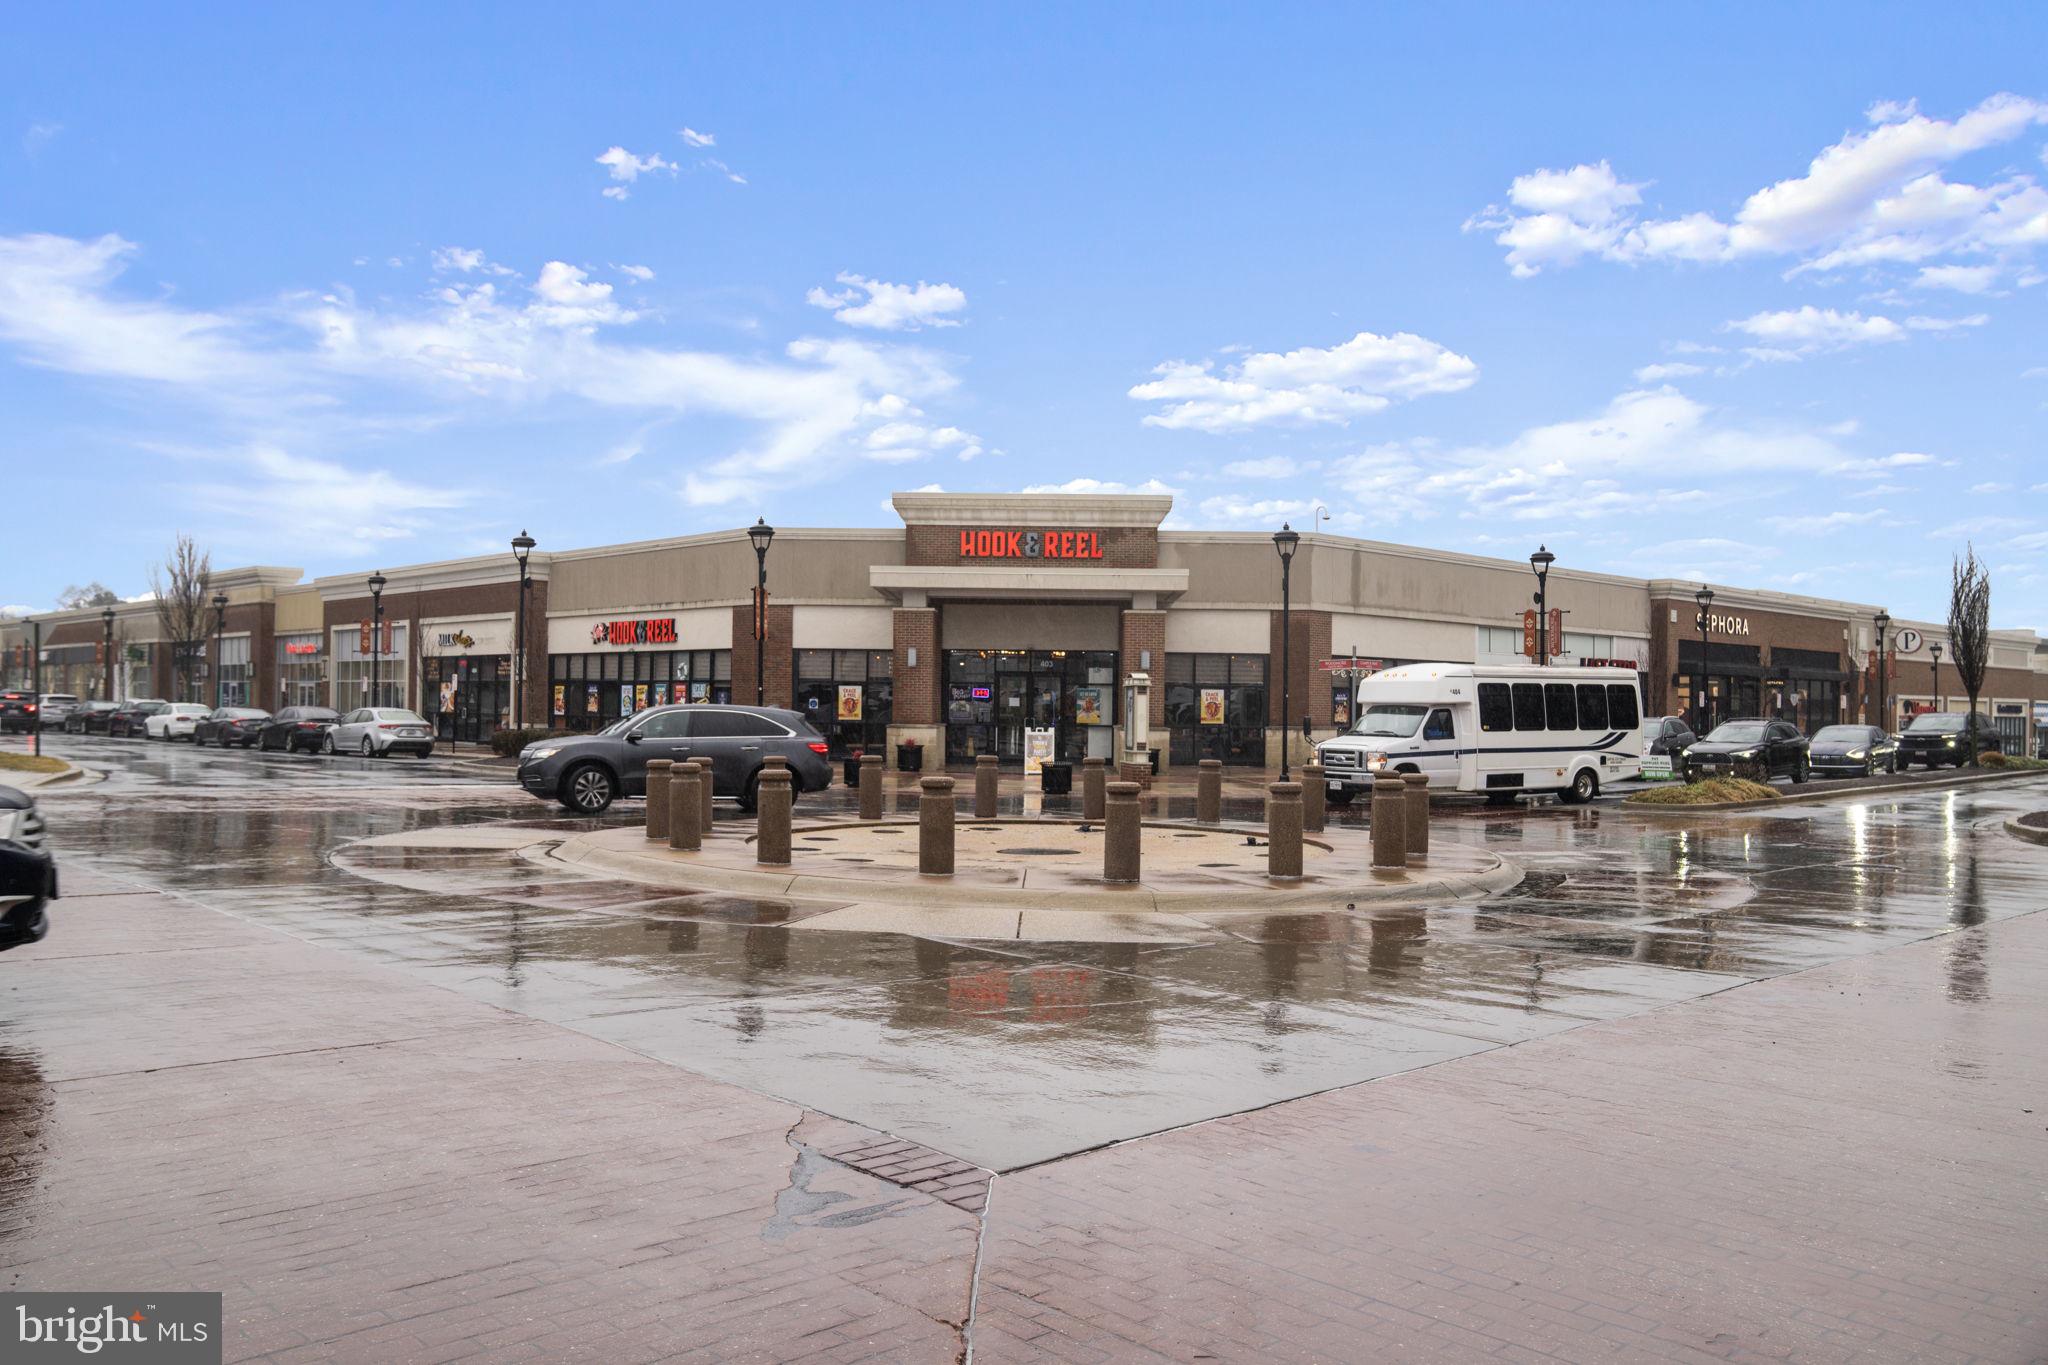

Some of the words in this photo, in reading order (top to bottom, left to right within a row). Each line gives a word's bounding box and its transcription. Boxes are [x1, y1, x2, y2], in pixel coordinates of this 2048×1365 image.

[960, 530, 1023, 557] HOOK
[1024, 531, 1041, 558] &
[1044, 531, 1103, 559] REEL
[609, 620, 637, 645] HOOK
[647, 618, 678, 643] REEL
[1904, 632, 1916, 650] P
